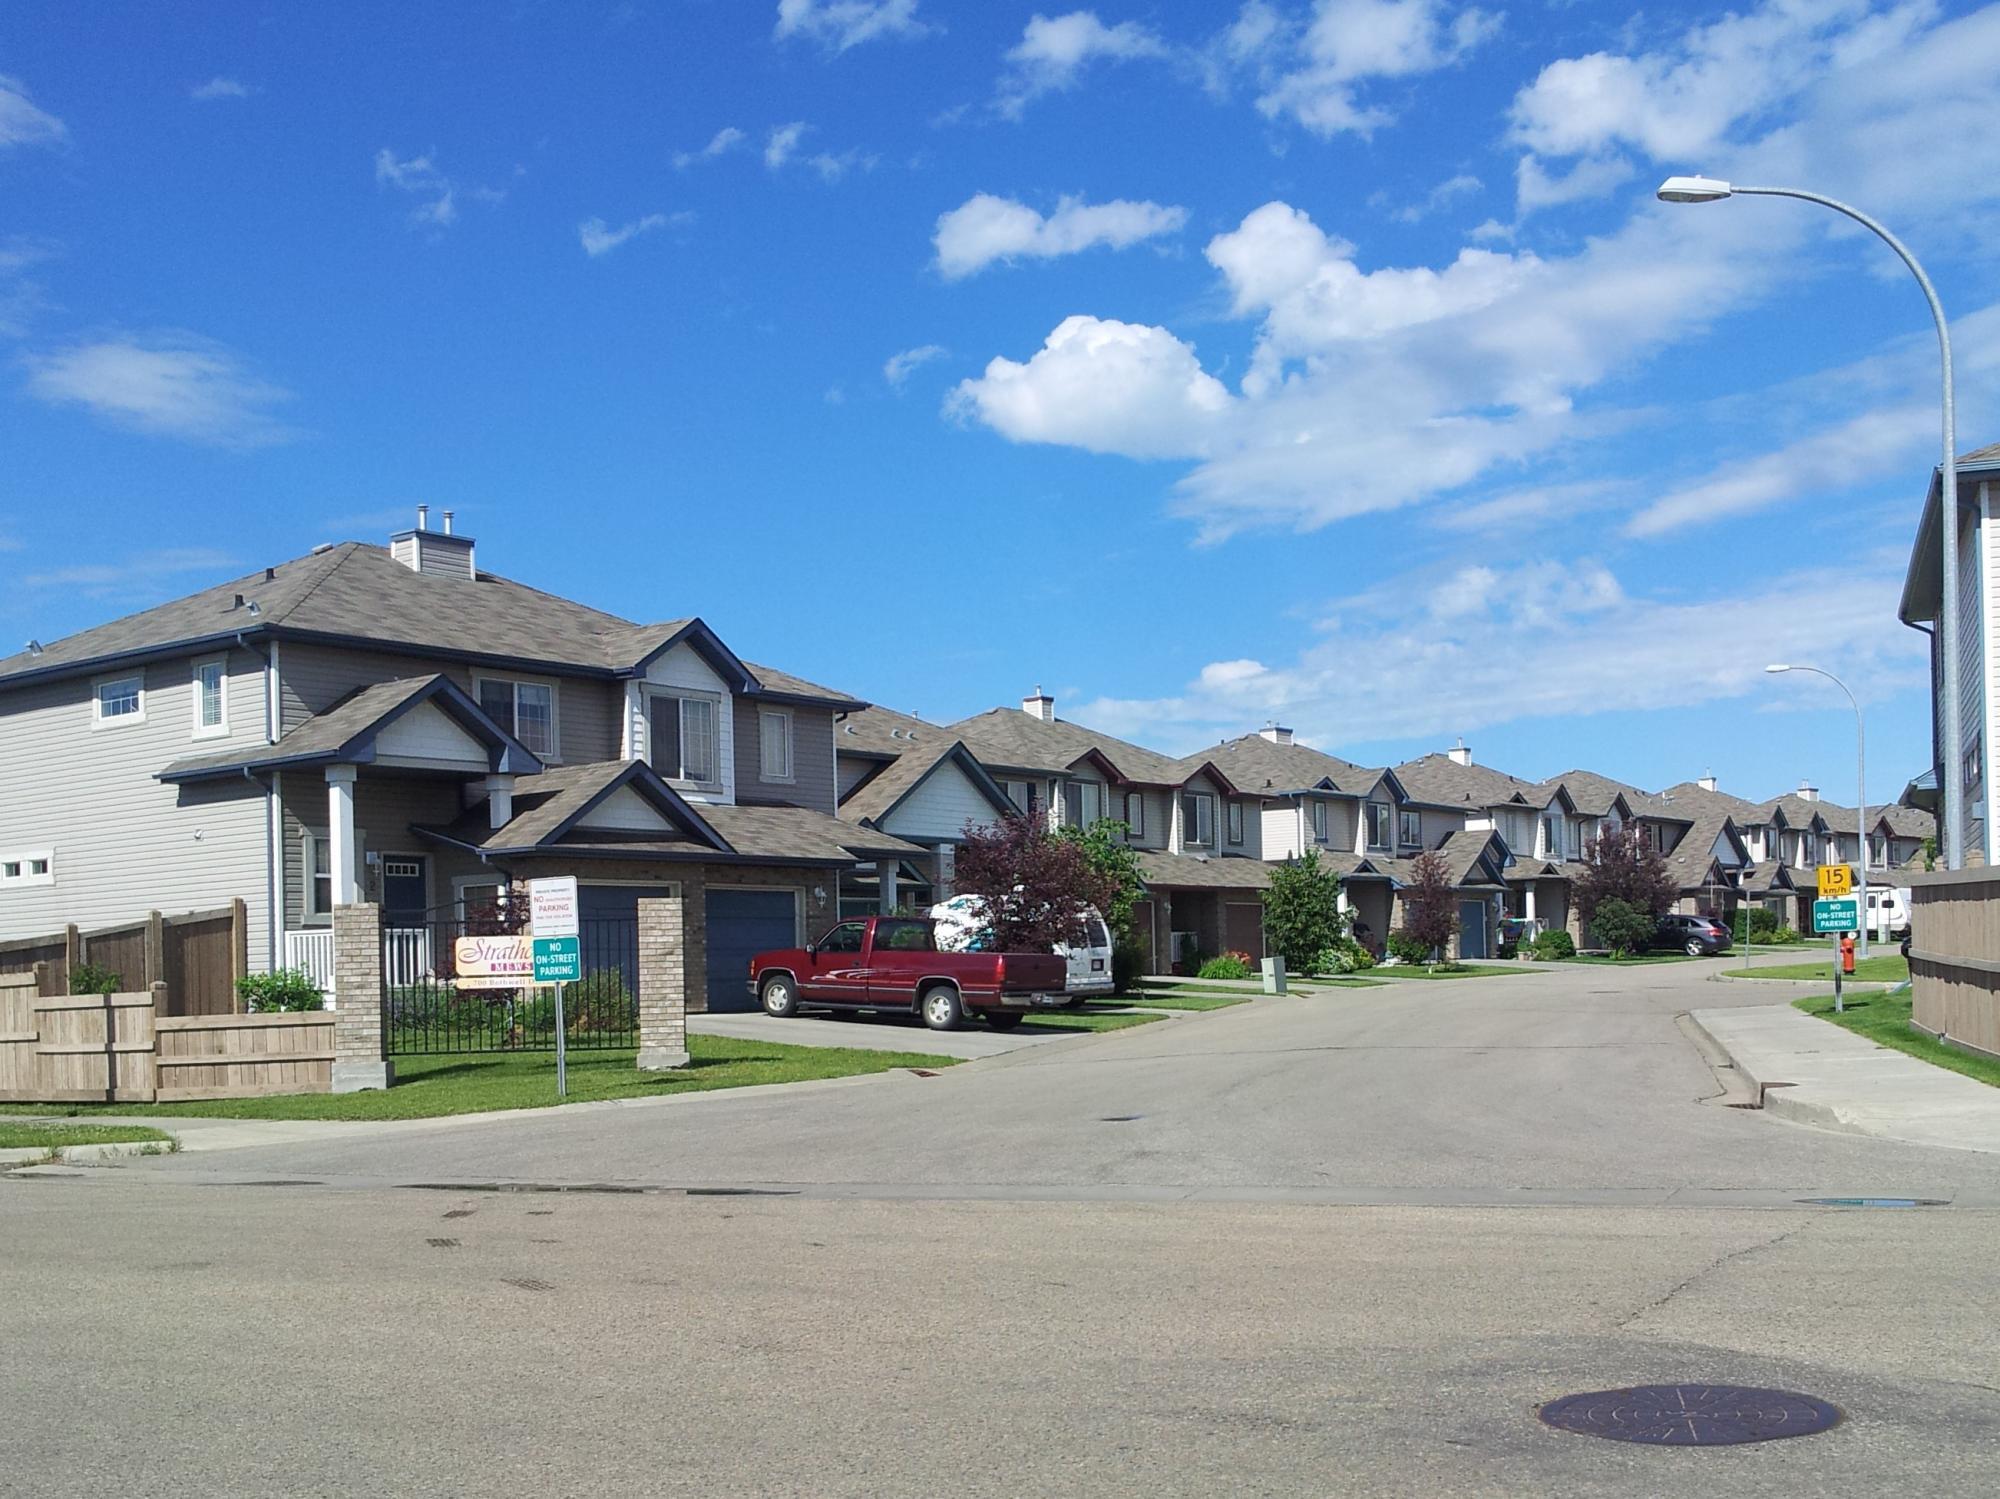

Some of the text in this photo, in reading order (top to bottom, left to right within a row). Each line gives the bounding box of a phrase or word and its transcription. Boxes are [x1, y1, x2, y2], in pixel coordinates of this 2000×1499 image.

[1825, 868, 1844, 884] 15
[1823, 886, 1847, 894] km/h
[533, 895, 544, 903] NO
[538, 904, 569, 912] PARKING
[1829, 903, 1841, 911] NO
[1816, 911, 1855, 919] ON-STREET
[1820, 919, 1852, 927] PARKING
[549, 942, 562, 952] NO
[535, 953, 577, 964] ON-STREET
[540, 965, 574, 976] PARKING
